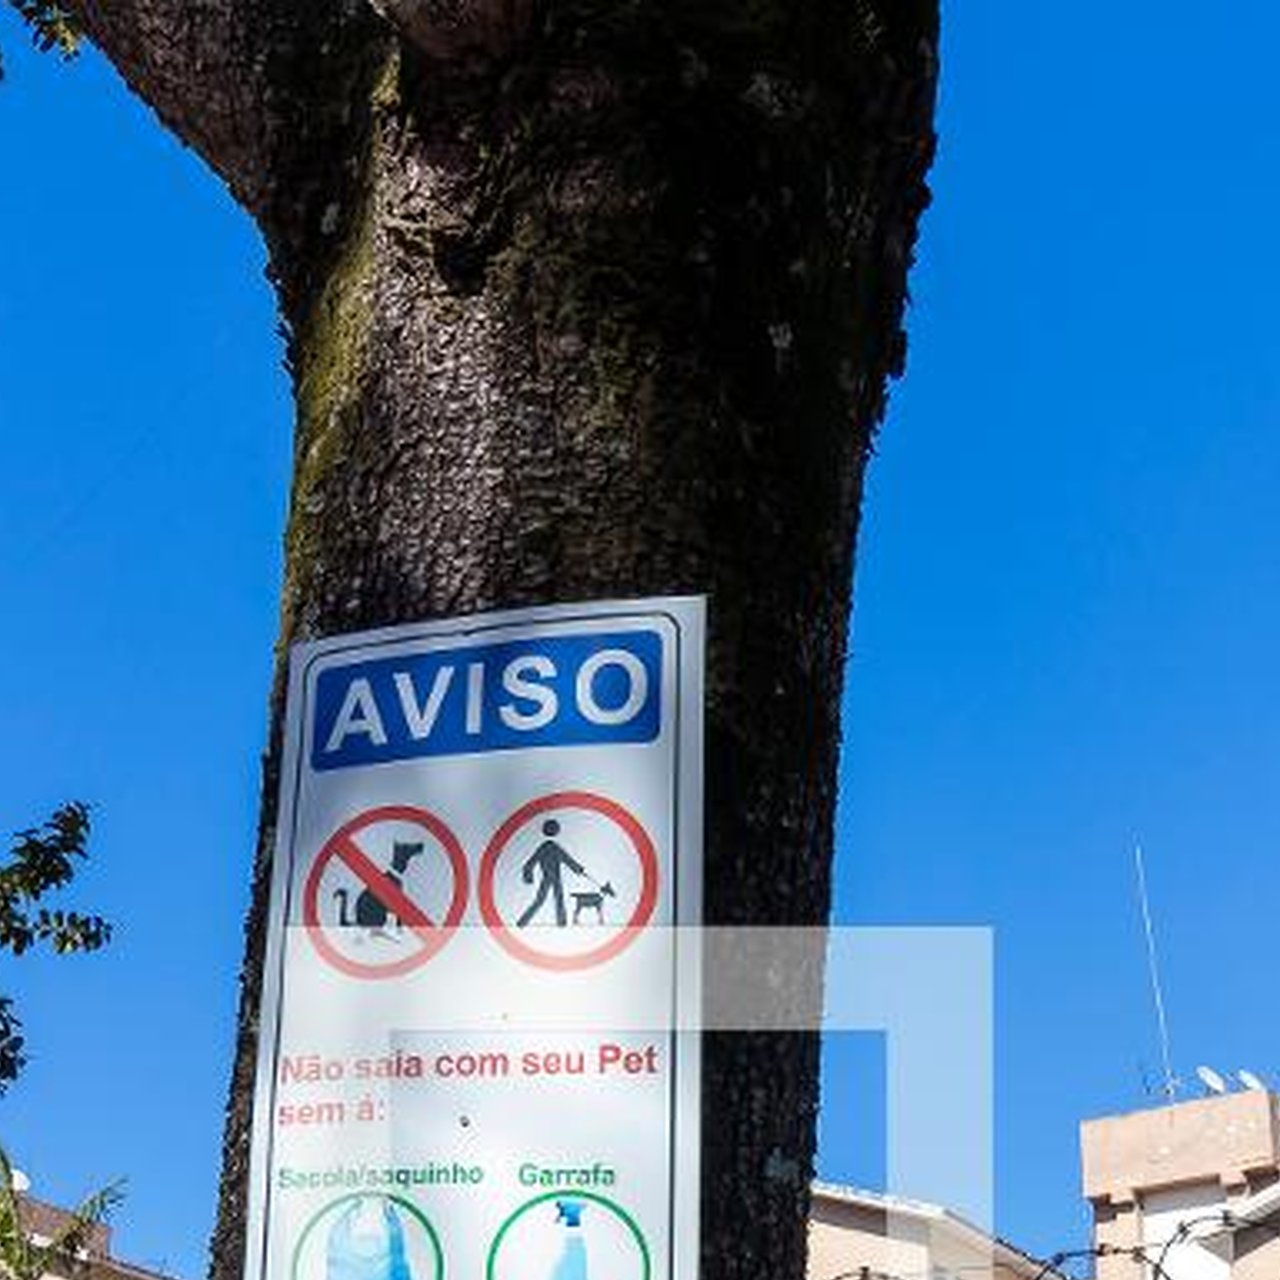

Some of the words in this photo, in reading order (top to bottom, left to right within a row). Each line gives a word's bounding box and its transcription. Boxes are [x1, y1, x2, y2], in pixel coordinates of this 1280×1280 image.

[325, 648, 650, 752] AVISO
[280, 1055, 344, 1085] Não
[354, 1050, 422, 1080] saia
[435, 1052, 510, 1077] com
[521, 1052, 585, 1075] seu
[598, 1044, 658, 1075] Pet
[278, 1100, 345, 1126] sem
[518, 1162, 616, 1187] Garrafa
